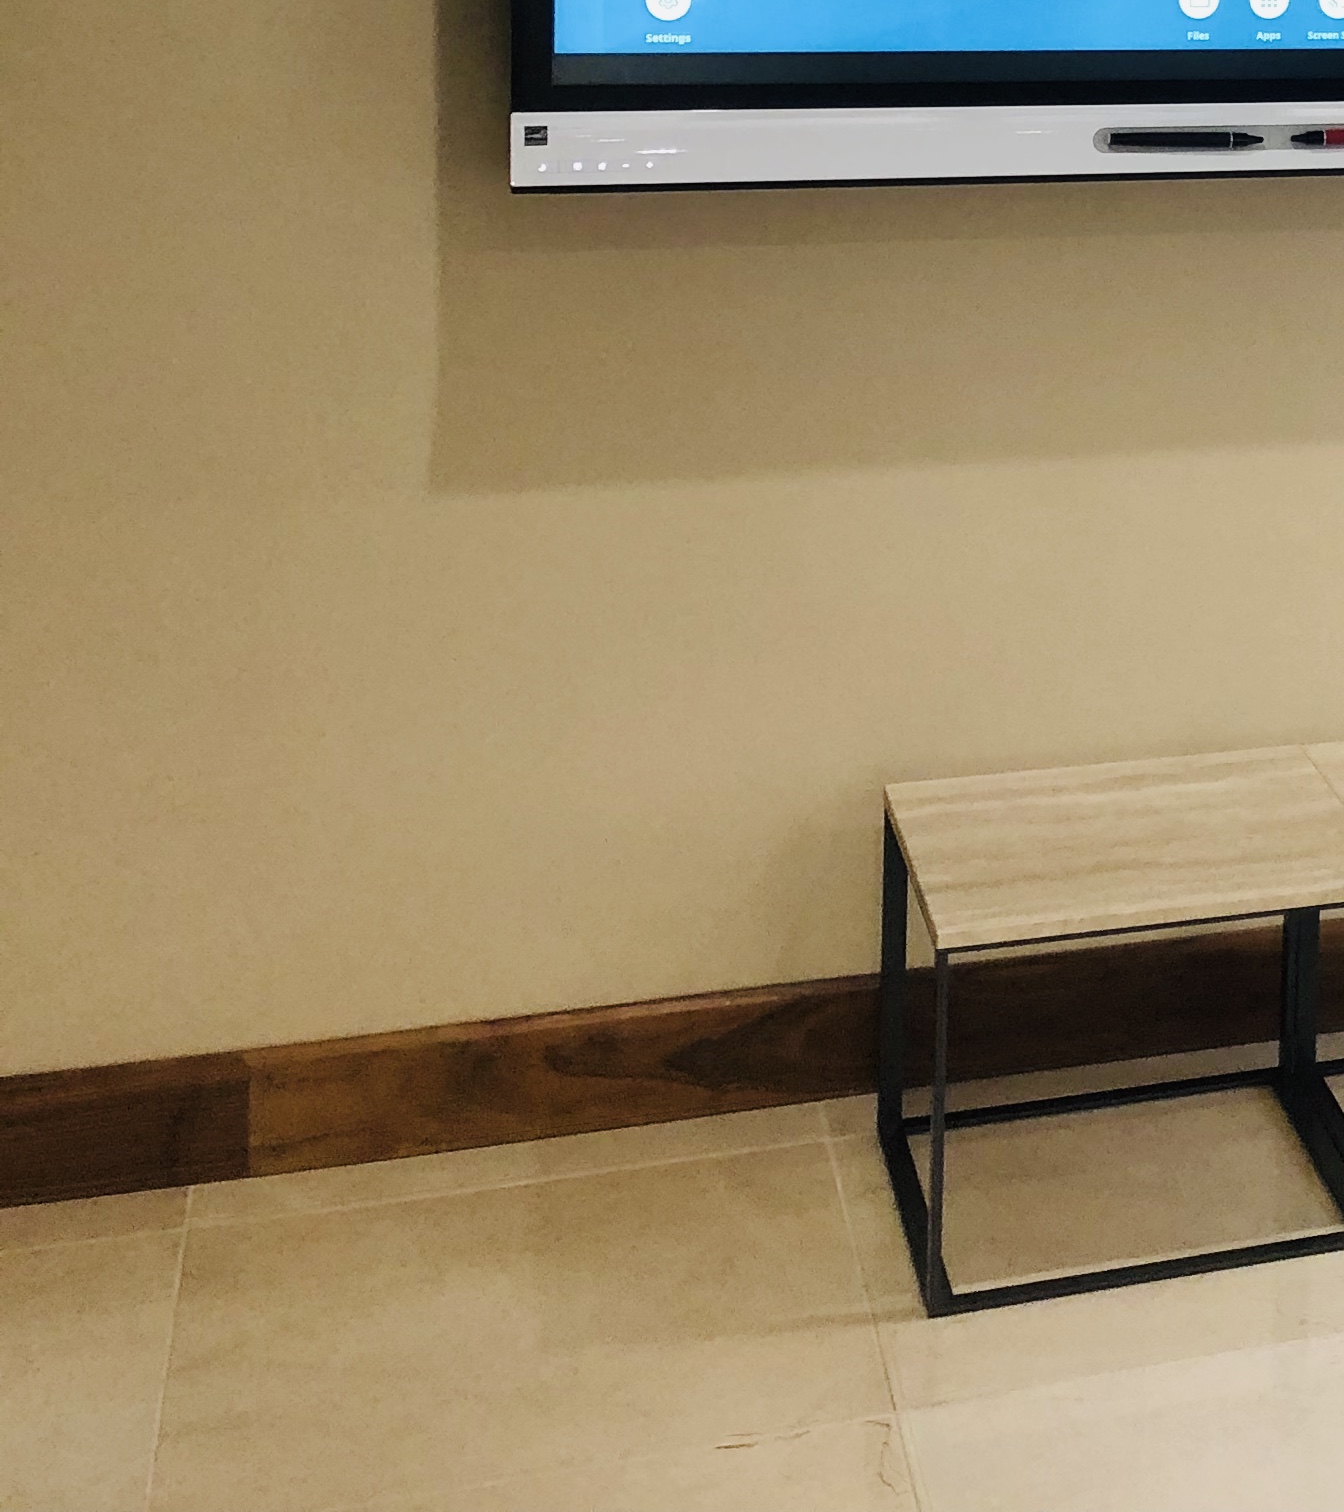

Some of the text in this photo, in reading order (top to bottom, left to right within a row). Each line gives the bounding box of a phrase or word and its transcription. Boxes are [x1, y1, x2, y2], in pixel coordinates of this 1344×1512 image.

[645, 33, 691, 45] Settings
[1187, 31, 1210, 41] Files
[1256, 31, 1281, 43] Apps
[1307, 30, 1340, 41] Screen
